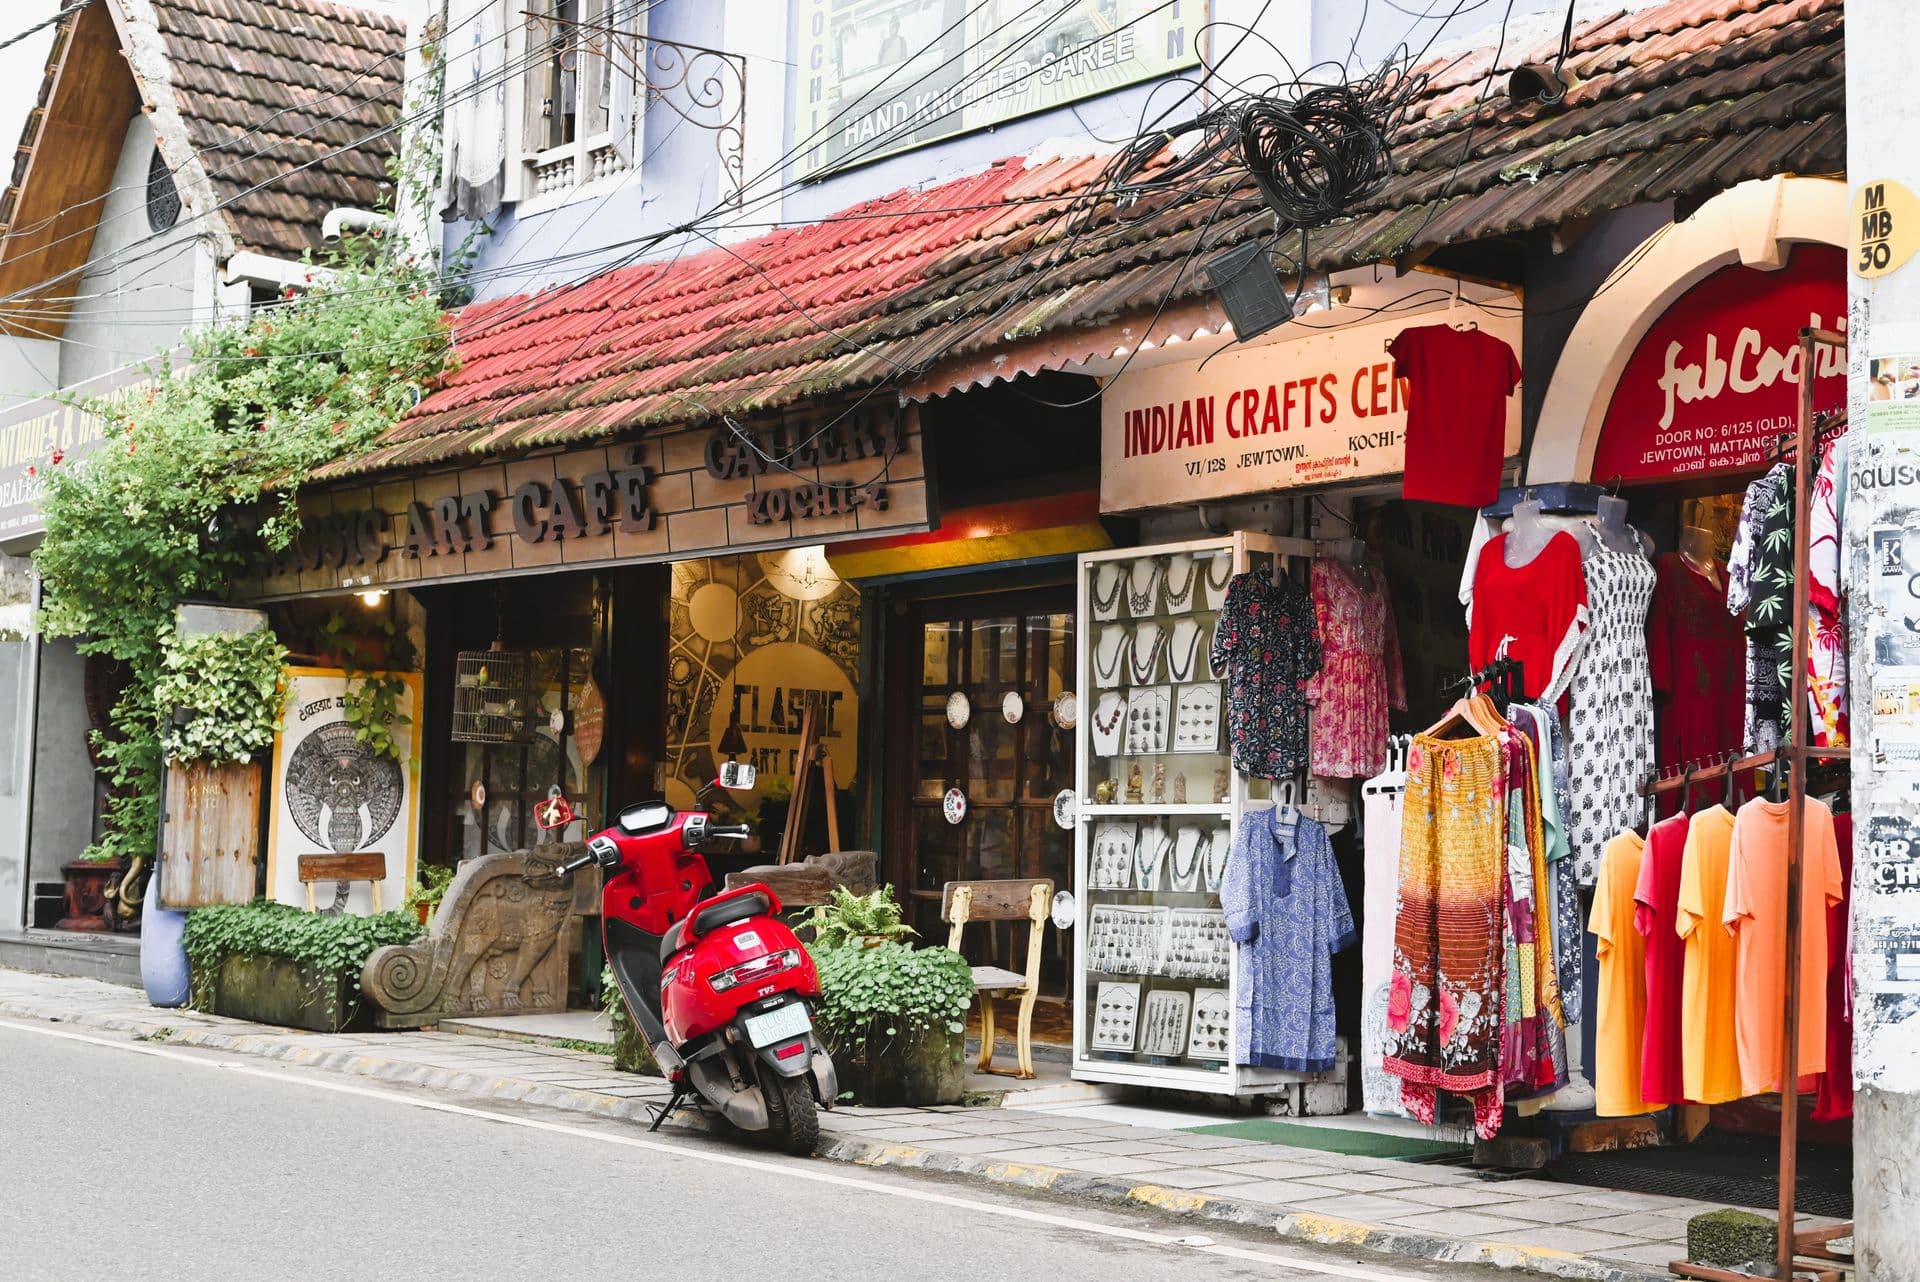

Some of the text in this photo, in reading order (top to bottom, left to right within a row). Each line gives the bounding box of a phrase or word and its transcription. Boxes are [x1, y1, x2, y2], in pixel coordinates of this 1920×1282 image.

[807, 0, 824, 169] OCHIN
[843, 102, 909, 147] HAND
[1039, 27, 1135, 86] SAREE
[1865, 184, 1885, 210] M
[1861, 210, 1893, 241] MB
[1859, 243, 1891, 272] 30
[1123, 361, 1411, 459] INDIAN CRAFTS CEN
[704, 409, 902, 480] GALLERY
[1656, 430, 1692, 446] DOOR
[1695, 426, 1718, 440] NO:
[1721, 421, 1753, 437] 6/125
[1185, 457, 1226, 478] VI/128
[1348, 429, 1408, 452] KOCHI-
[1640, 443, 1707, 464] JEWTOWN,
[1851, 464, 1920, 502] paus
[402, 489, 497, 560] ART
[758, 985, 775, 997] TVS
